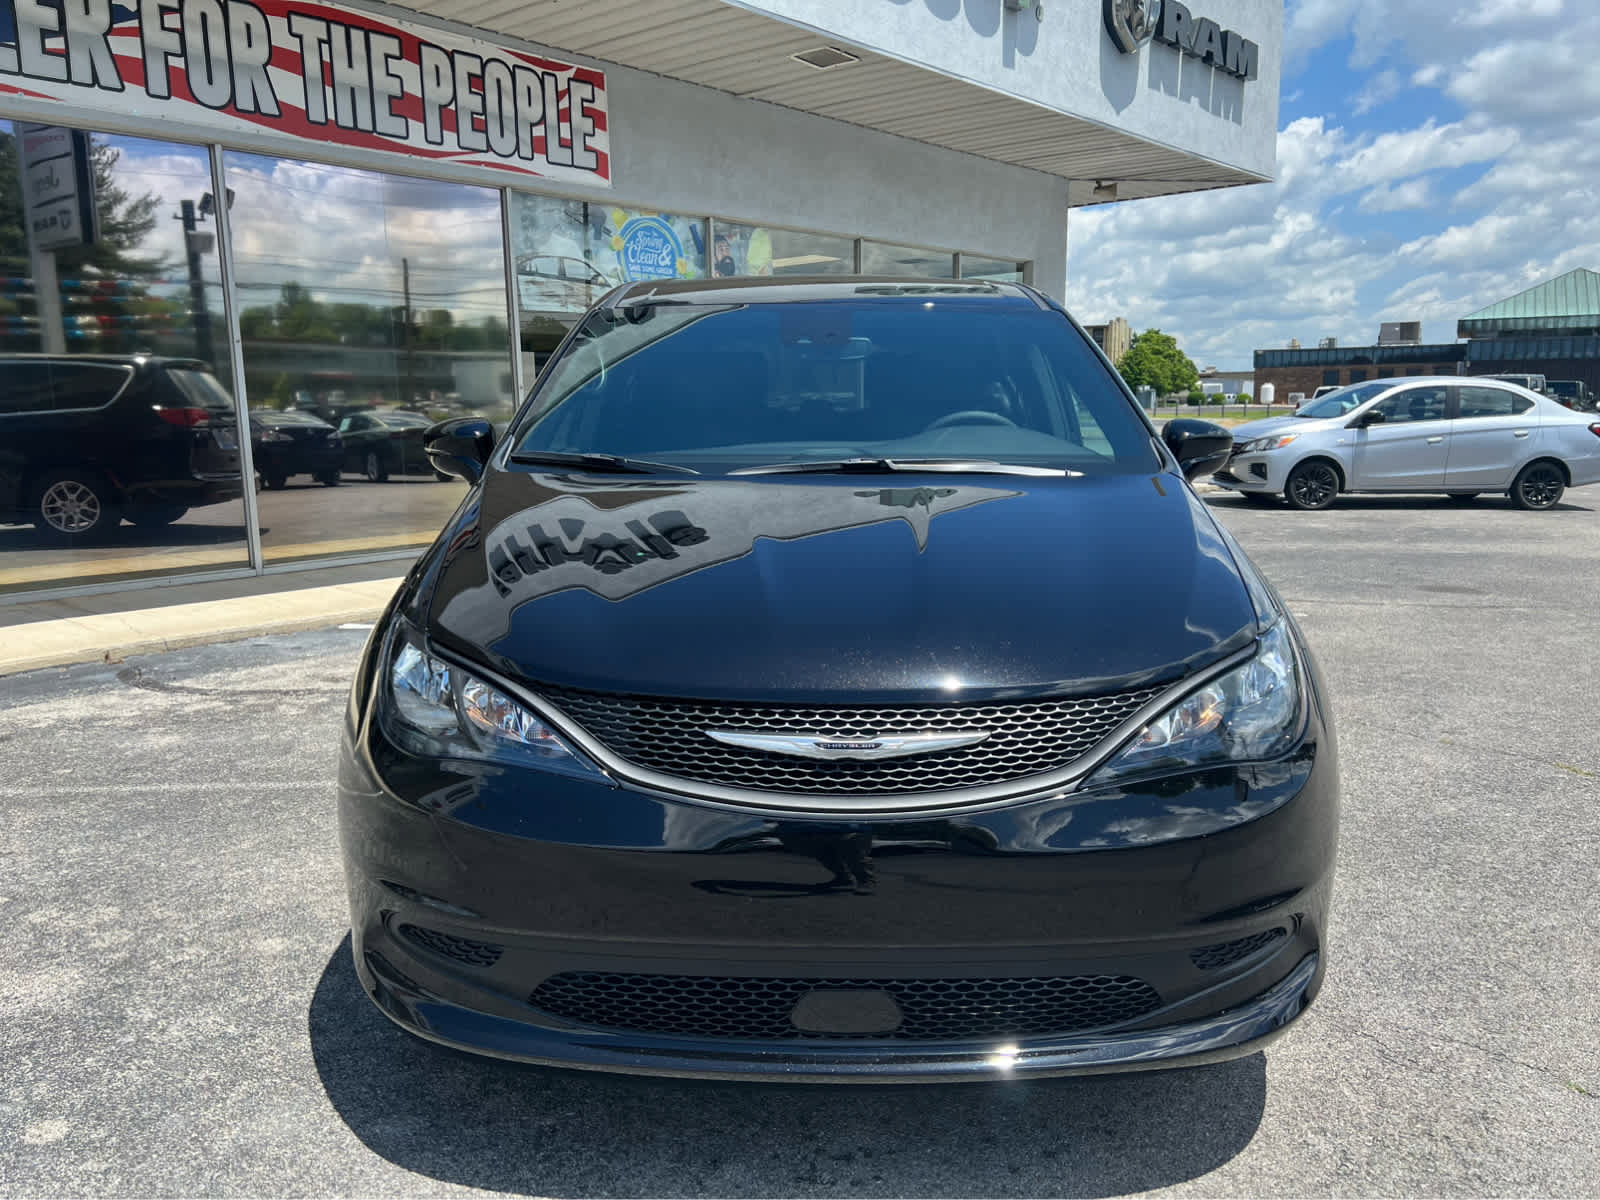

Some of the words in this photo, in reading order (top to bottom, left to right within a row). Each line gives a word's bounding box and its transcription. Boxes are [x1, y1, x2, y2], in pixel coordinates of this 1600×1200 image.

[1153, 0, 1258, 81] RAM
[138, 0, 282, 117] FOR
[287, 11, 409, 139] THE
[419, 42, 598, 170] PEOPLE
[627, 241, 658, 265] Clean
